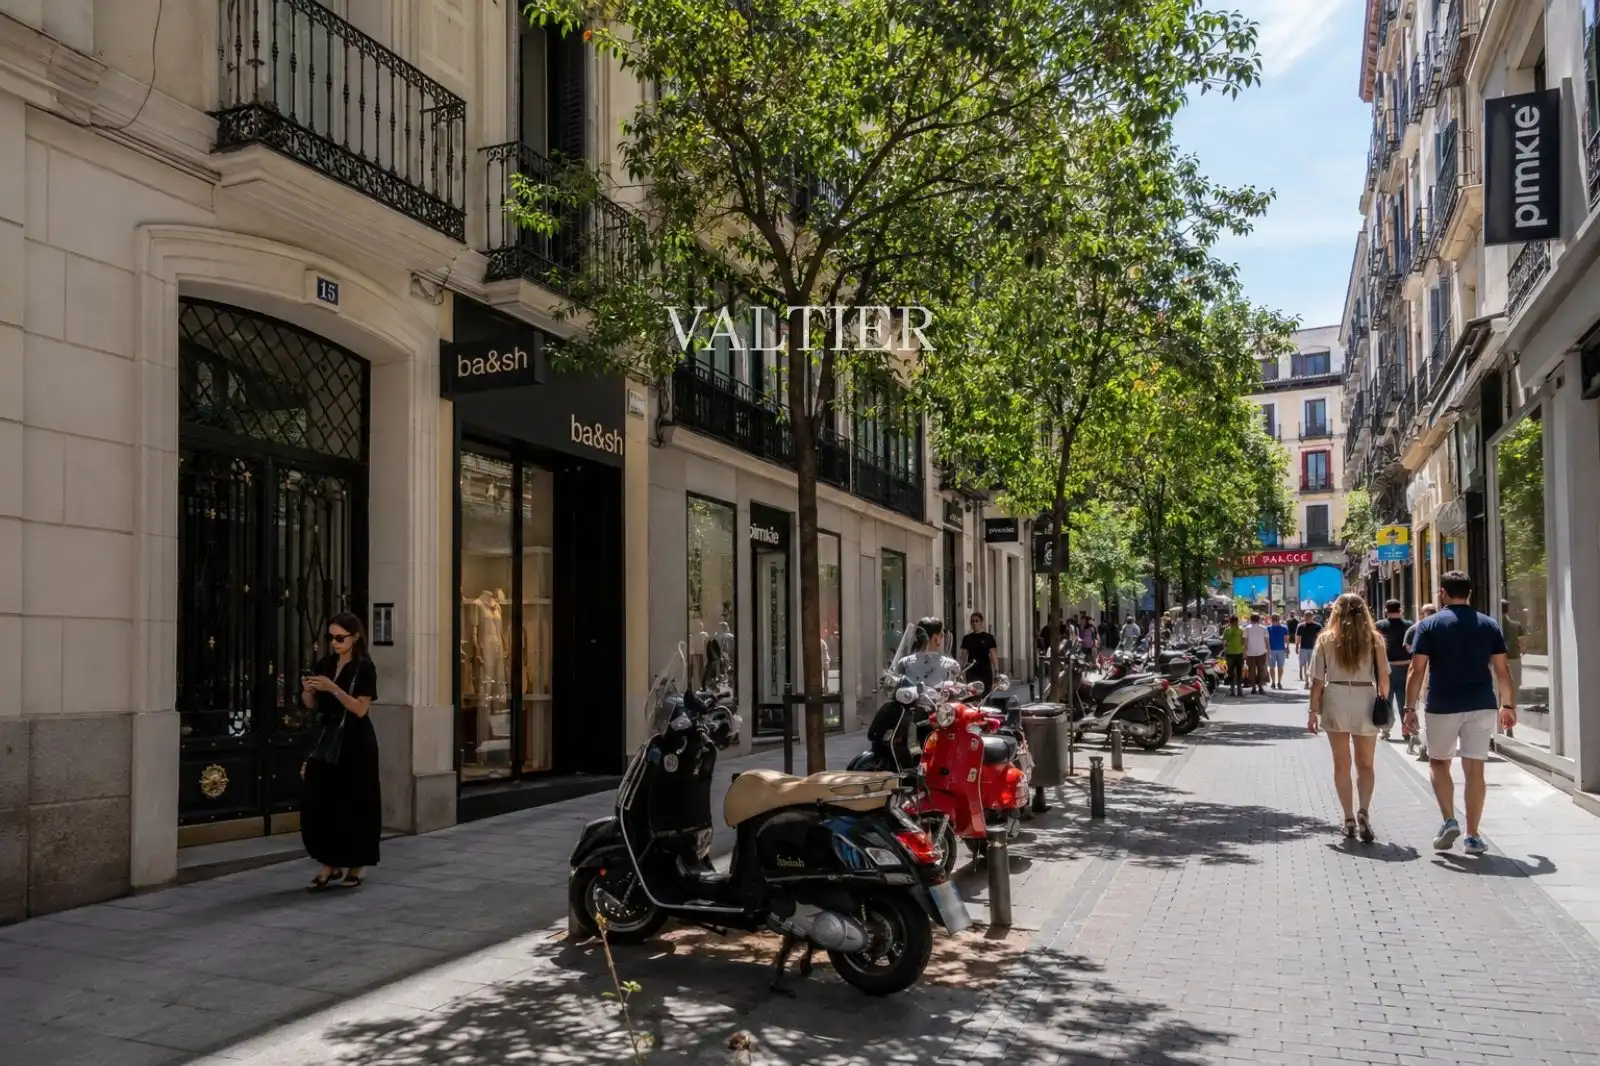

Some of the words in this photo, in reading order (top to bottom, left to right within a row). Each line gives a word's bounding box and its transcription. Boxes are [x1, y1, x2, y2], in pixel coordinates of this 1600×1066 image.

[320, 281, 336, 301] 15
[457, 346, 528, 377] ba&sh
[570, 414, 624, 455] ba&sh
